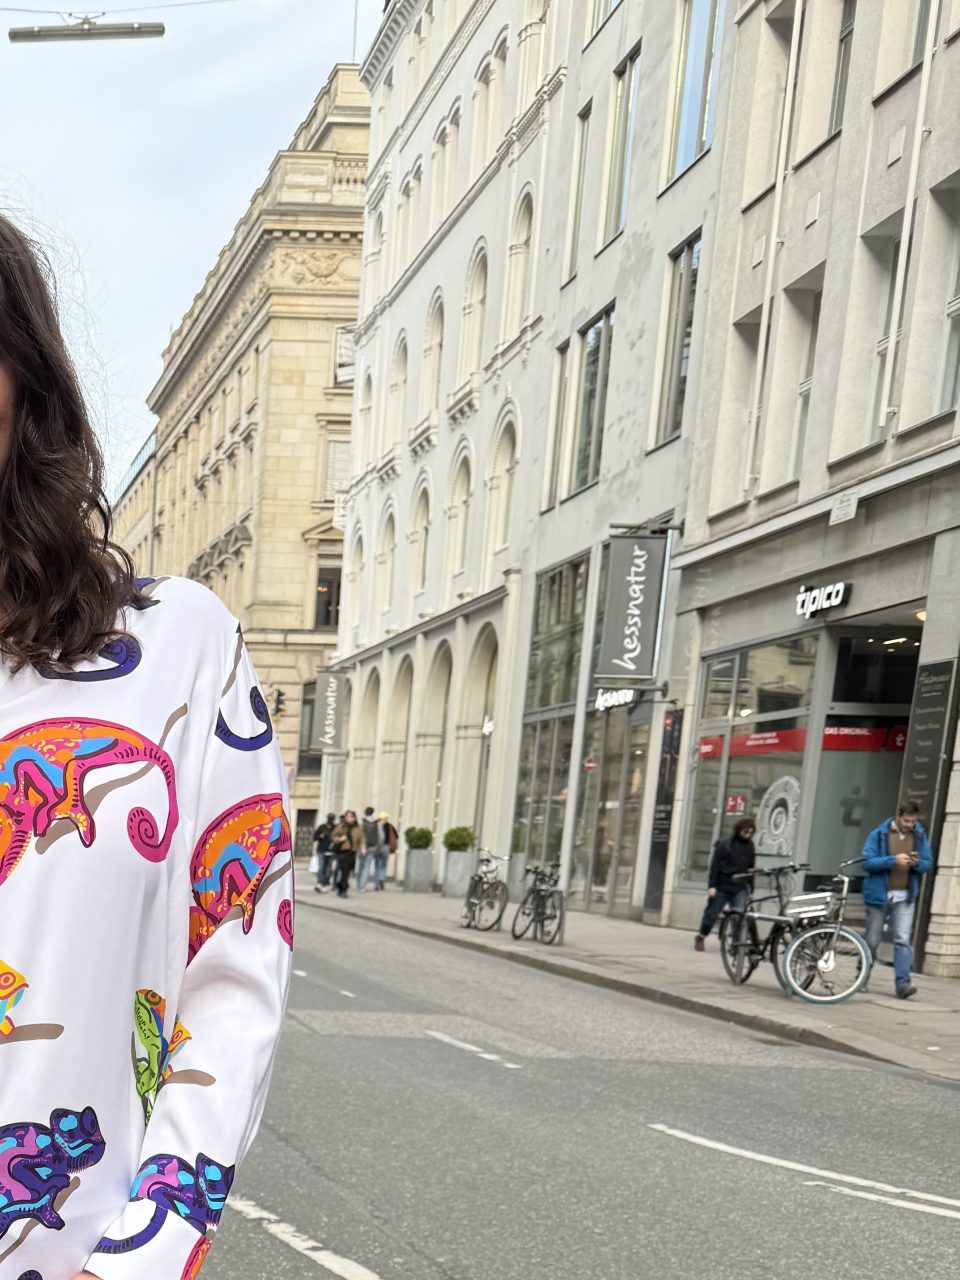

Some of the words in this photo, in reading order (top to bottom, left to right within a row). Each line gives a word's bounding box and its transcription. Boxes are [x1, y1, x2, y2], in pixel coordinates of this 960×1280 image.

[611, 544, 649, 670] hessnatur
[795, 582, 845, 619] tipico
[319, 676, 338, 745] hessnatur
